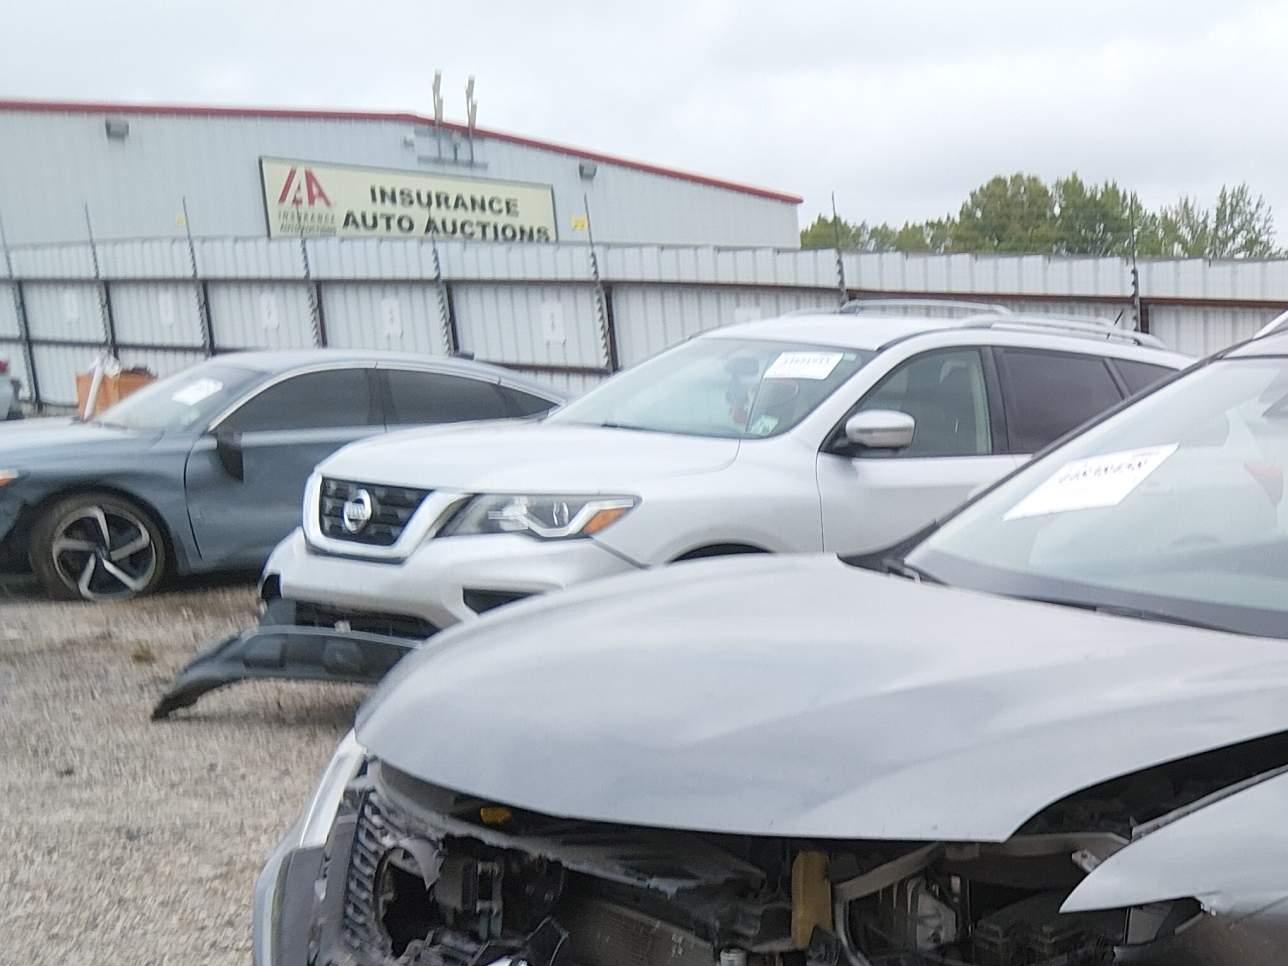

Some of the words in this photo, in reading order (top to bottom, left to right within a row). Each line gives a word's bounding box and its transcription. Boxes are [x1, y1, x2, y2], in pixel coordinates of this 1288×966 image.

[370, 185, 519, 217] INSURANCE
[342, 209, 415, 233] AUTO
[424, 216, 550, 243] AUCTIONS
